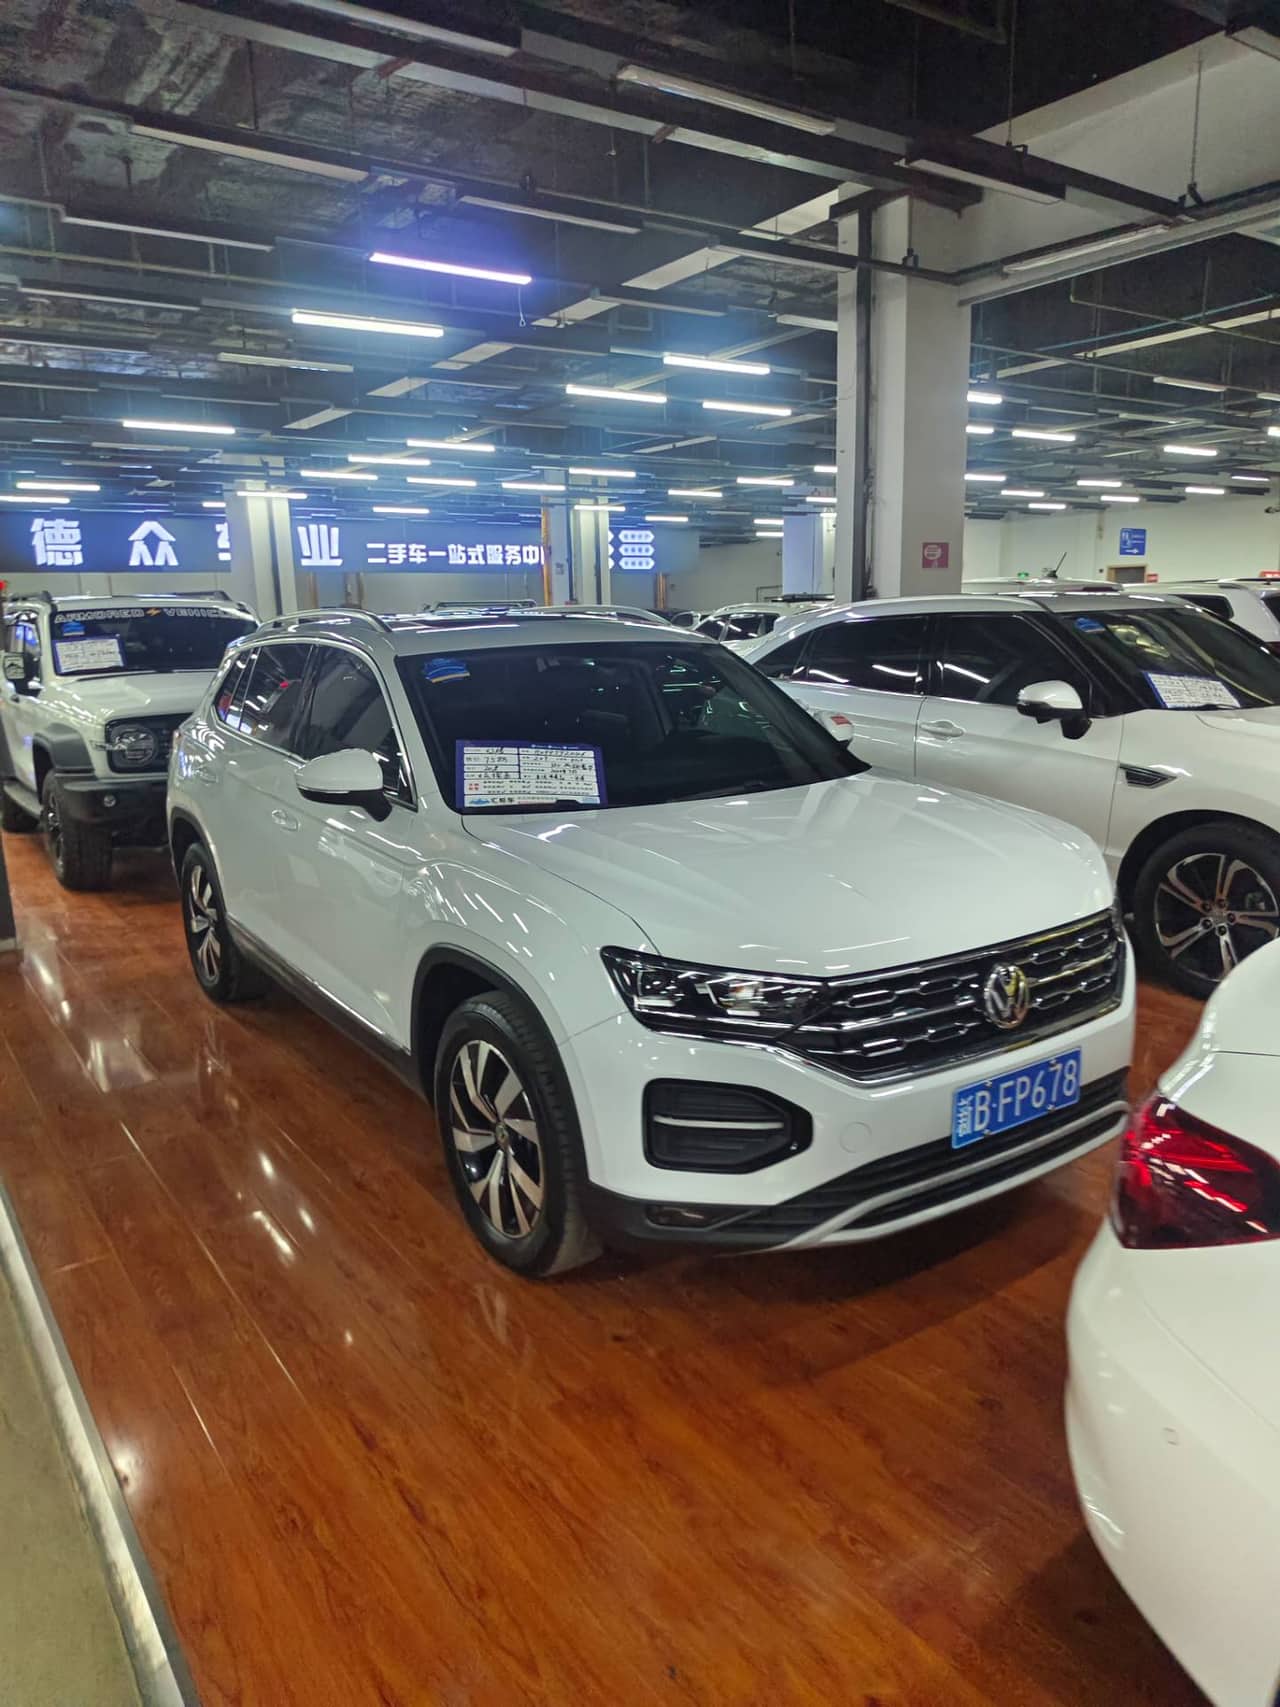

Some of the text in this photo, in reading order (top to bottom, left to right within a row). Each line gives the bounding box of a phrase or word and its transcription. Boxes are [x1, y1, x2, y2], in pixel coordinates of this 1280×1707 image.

[366, 542, 546, 566] 二手车一站式服务中
